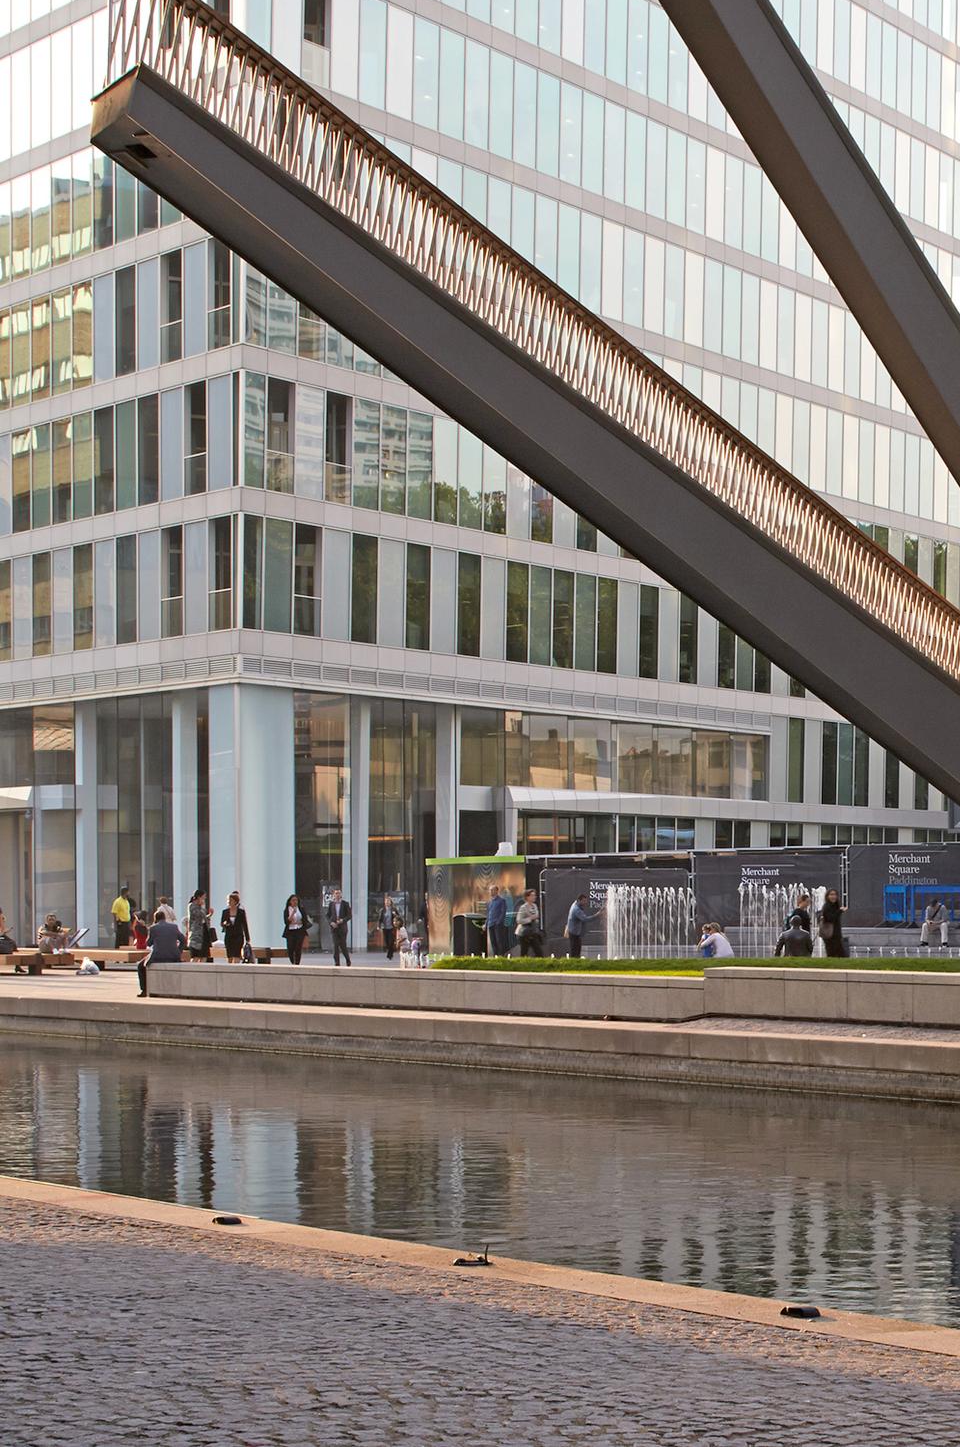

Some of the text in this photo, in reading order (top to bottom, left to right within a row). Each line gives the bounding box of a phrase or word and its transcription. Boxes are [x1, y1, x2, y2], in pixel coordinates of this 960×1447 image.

[888, 854, 931, 864] Merchant
[741, 867, 780, 876] Merchant
[888, 864, 921, 876] Square
[741, 876, 770, 885] Square
